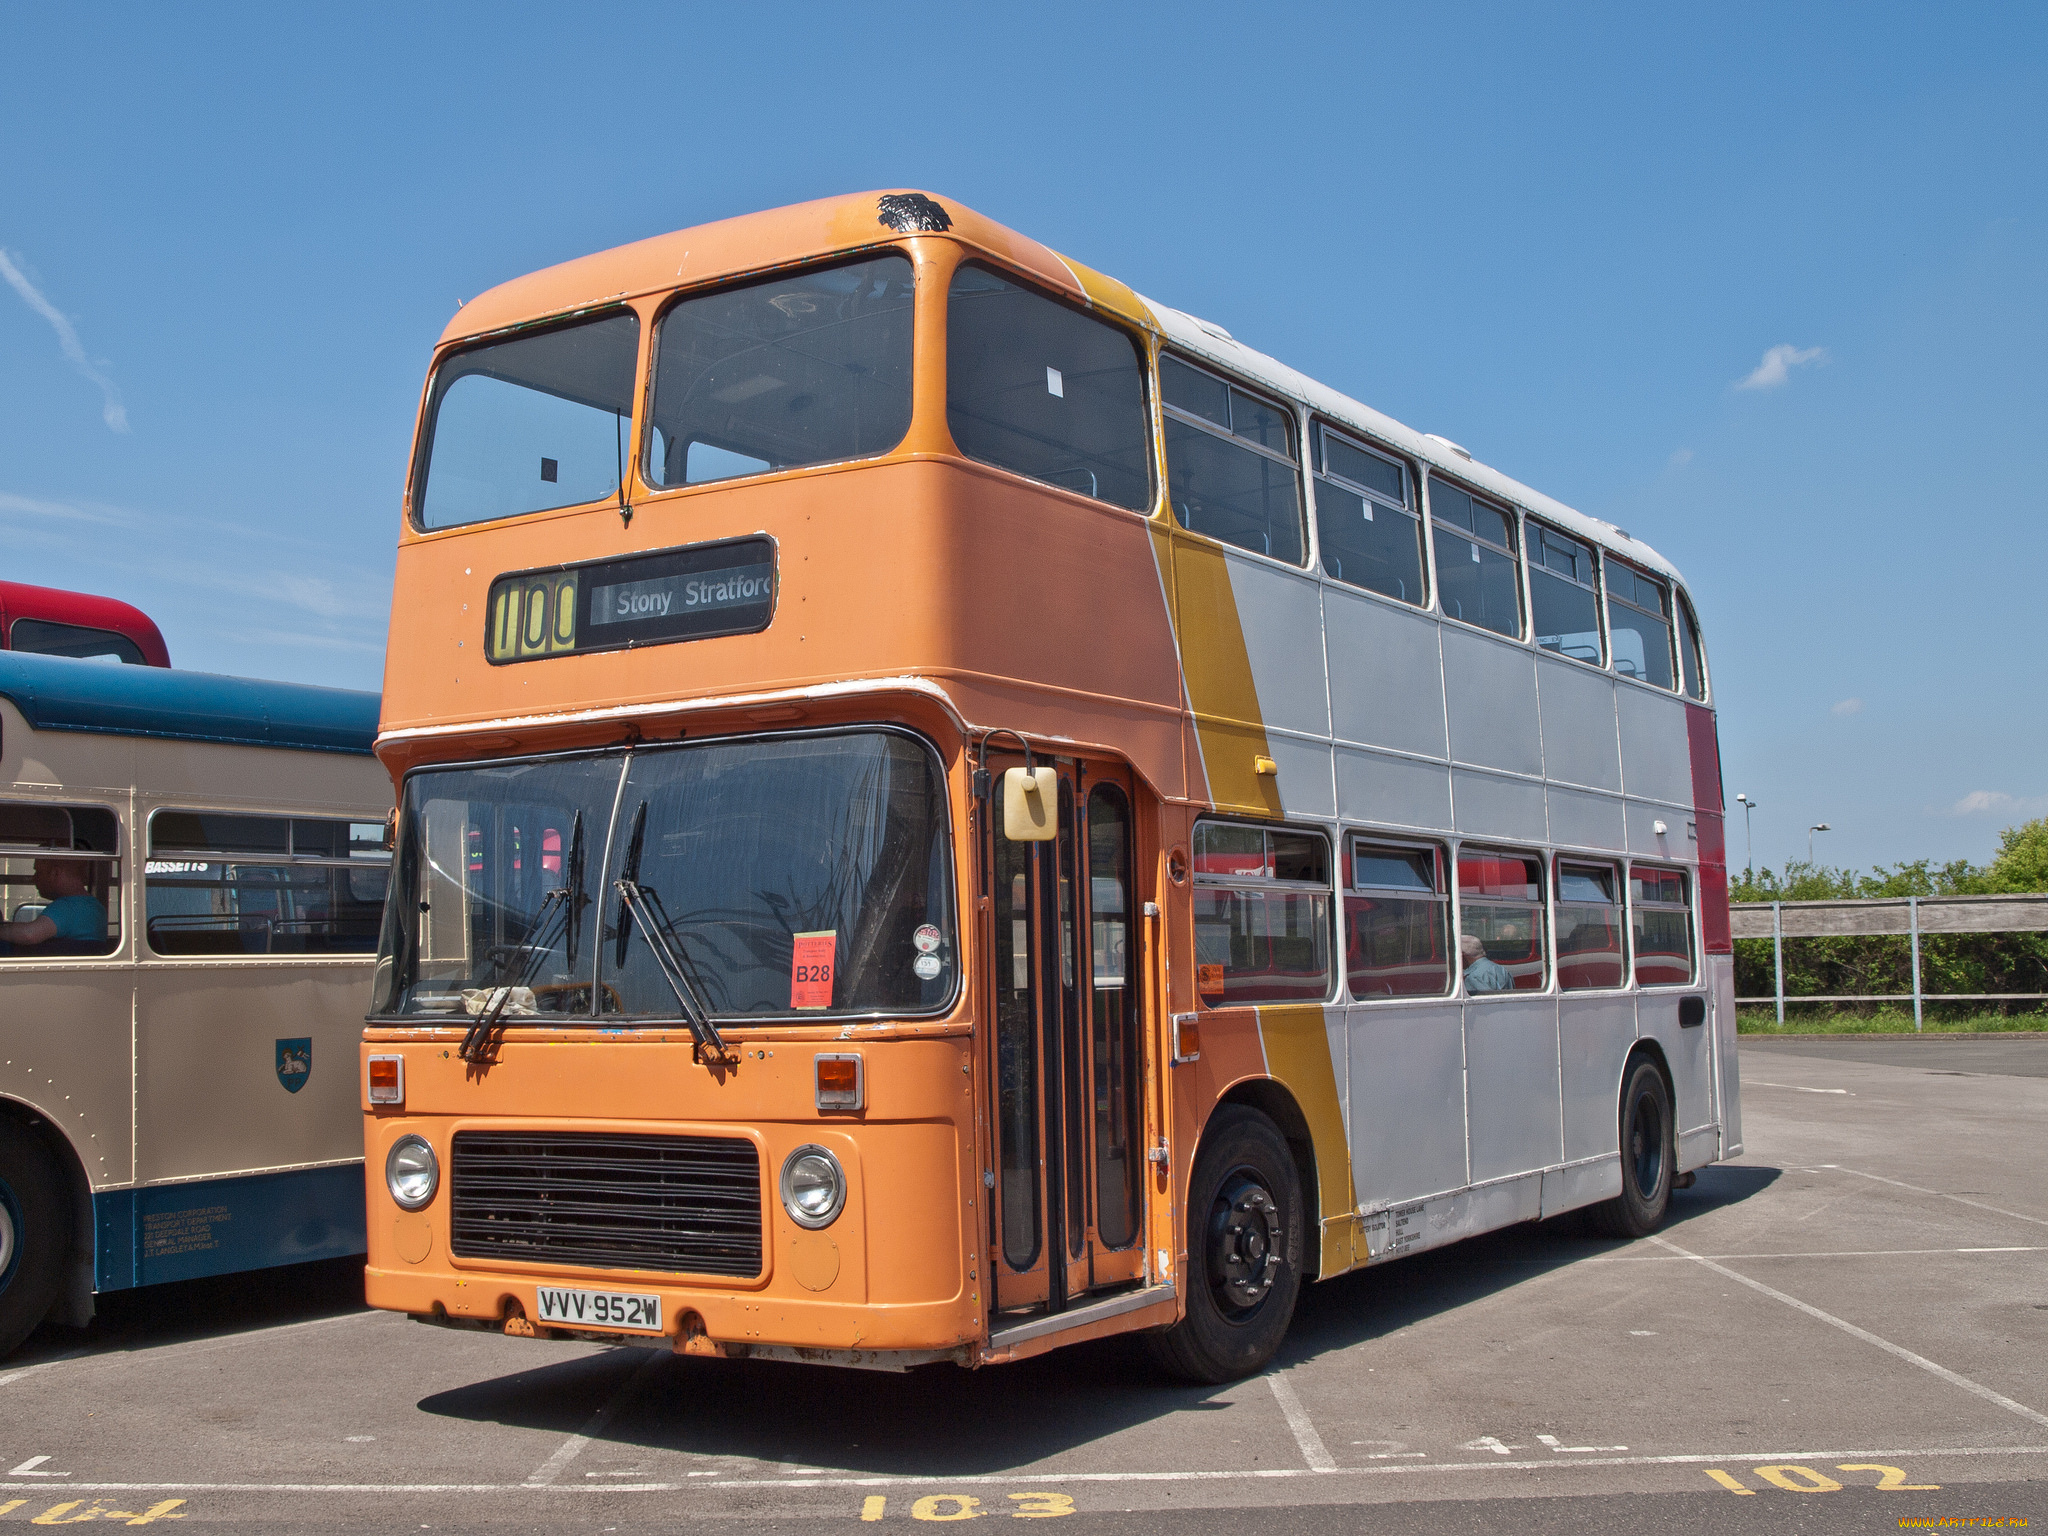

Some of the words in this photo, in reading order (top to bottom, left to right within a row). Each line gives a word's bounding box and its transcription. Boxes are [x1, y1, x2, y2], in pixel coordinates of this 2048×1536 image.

[500, 578, 577, 651] 100
[617, 590, 673, 616] Stony
[796, 965, 830, 983] B28
[143, 1211, 176, 1222] PRESTON
[177, 1206, 228, 1219] CORPORATION
[143, 1219, 185, 1231] TRANSPORT
[187, 1213, 232, 1226] DEPARTMENT
[154, 1226, 189, 1239] DEEPDALE
[190, 1224, 212, 1234] ROAD
[177, 1233, 212, 1244] MANAGER
[541, 1291, 586, 1319] VVV
[593, 1295, 657, 1325] 952W
[1703, 1464, 1941, 1496] 102
[861, 1492, 1077, 1522] 103
